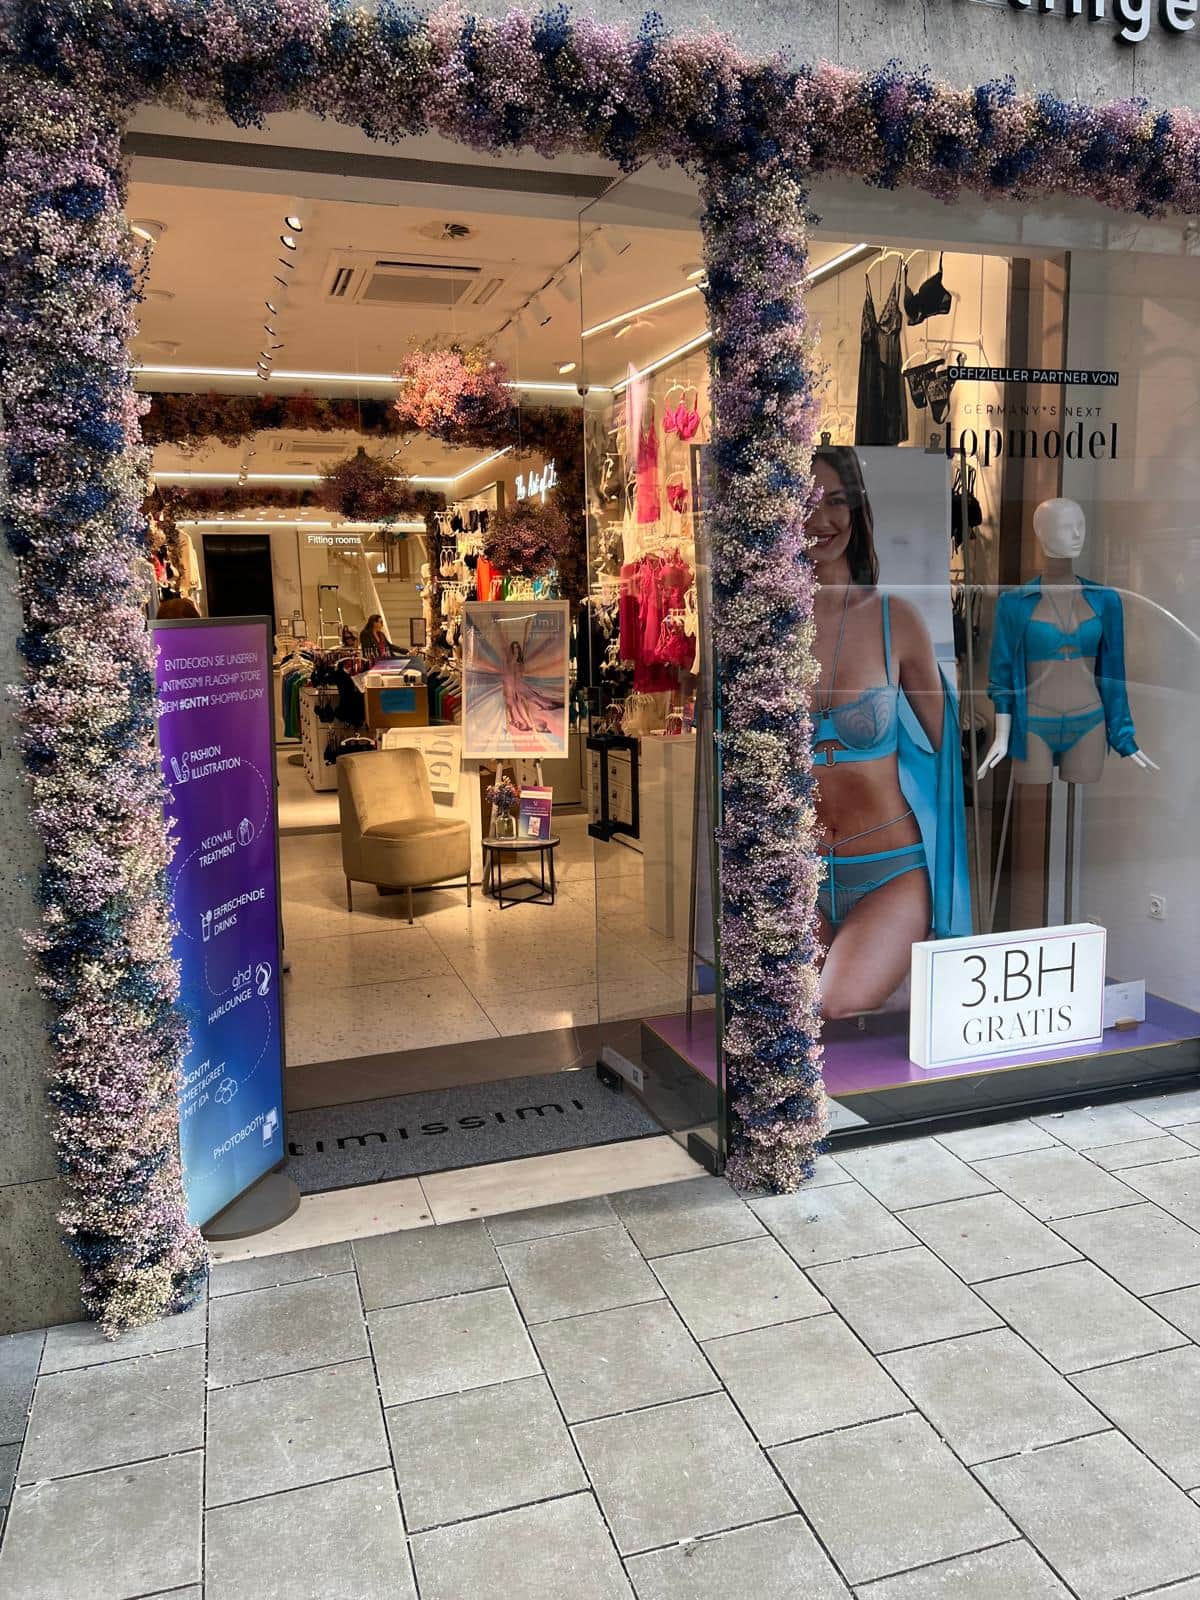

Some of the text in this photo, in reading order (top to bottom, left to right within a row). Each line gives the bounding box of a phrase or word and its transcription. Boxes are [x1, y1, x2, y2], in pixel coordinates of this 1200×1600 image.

[949, 368, 1118, 385] OFFIZIELLER PARTNER VON
[1065, 406, 1103, 418] NEXT
[945, 422, 1119, 467] topmodel
[307, 535, 362, 546] Fitting rooms
[165, 653, 257, 672] ENTDECKEN SIE UNSEREN
[205, 674, 239, 687] FLAGSHIP
[240, 670, 262, 682] STORE
[180, 696, 209, 711] #GNTM
[211, 689, 247, 705] SHOPPING
[248, 688, 264, 700] DAY
[190, 744, 221, 763] FASHION
[191, 756, 241, 779] ILLUSTRATION
[201, 829, 234, 851] NEONAIL
[198, 842, 237, 868] TREATMENT
[213, 888, 265, 920] ERFRISCHENDE
[213, 913, 238, 936] DRINKS
[231, 963, 252, 992] ghd
[961, 942, 1077, 1008] 3.BH
[207, 988, 253, 1025] HAIRLOUNGE
[962, 1005, 1073, 1046] GRATIS
[198, 1091, 210, 1109] IDA
[213, 1112, 265, 1160] PHOTOBOOTH
